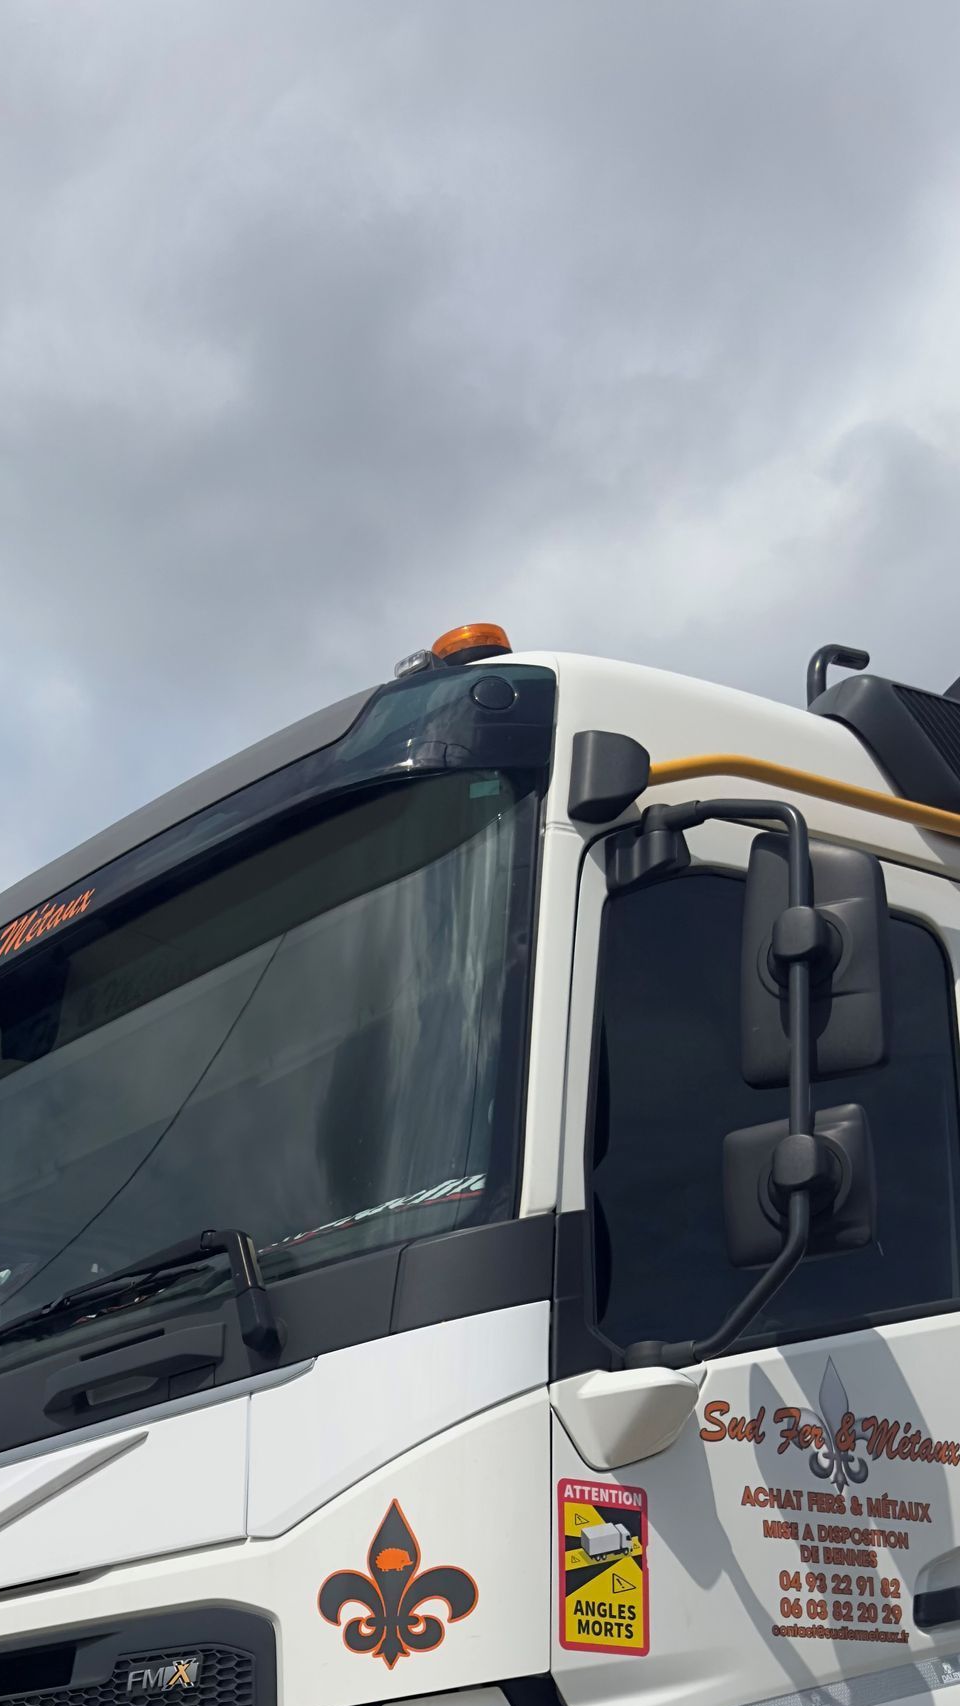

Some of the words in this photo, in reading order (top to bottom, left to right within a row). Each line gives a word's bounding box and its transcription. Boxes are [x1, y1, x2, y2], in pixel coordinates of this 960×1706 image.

[699, 1400, 766, 1445] Sud
[773, 1406, 826, 1455] Fer
[835, 1411, 857, 1452] &
[861, 1415, 960, 1467] Métaux
[564, 1484, 642, 1506] ATTENTION
[741, 1486, 803, 1511] ACHAT
[807, 1491, 846, 1515] FERS
[850, 1495, 863, 1516] &
[866, 1492, 932, 1523] MÉTAUX
[762, 1520, 799, 1540] MISE
[802, 1523, 815, 1542] A
[817, 1524, 910, 1549] DISPOSITION
[800, 1544, 820, 1563] DE
[823, 1546, 878, 1569] BENNES
[779, 1570, 802, 1592] 04
[805, 1571, 827, 1593] 93
[831, 1573, 853, 1595] 22
[855, 1575, 874, 1597] 91
[880, 1577, 901, 1599] 82
[573, 1599, 636, 1621] ANGLES
[780, 1597, 803, 1619] 06
[806, 1598, 828, 1620] 03
[832, 1600, 854, 1622] 82
[857, 1601, 878, 1623] 20
[881, 1603, 903, 1624] 29
[577, 1619, 634, 1639] MORTS
[127, 1657, 197, 1692] FMX
